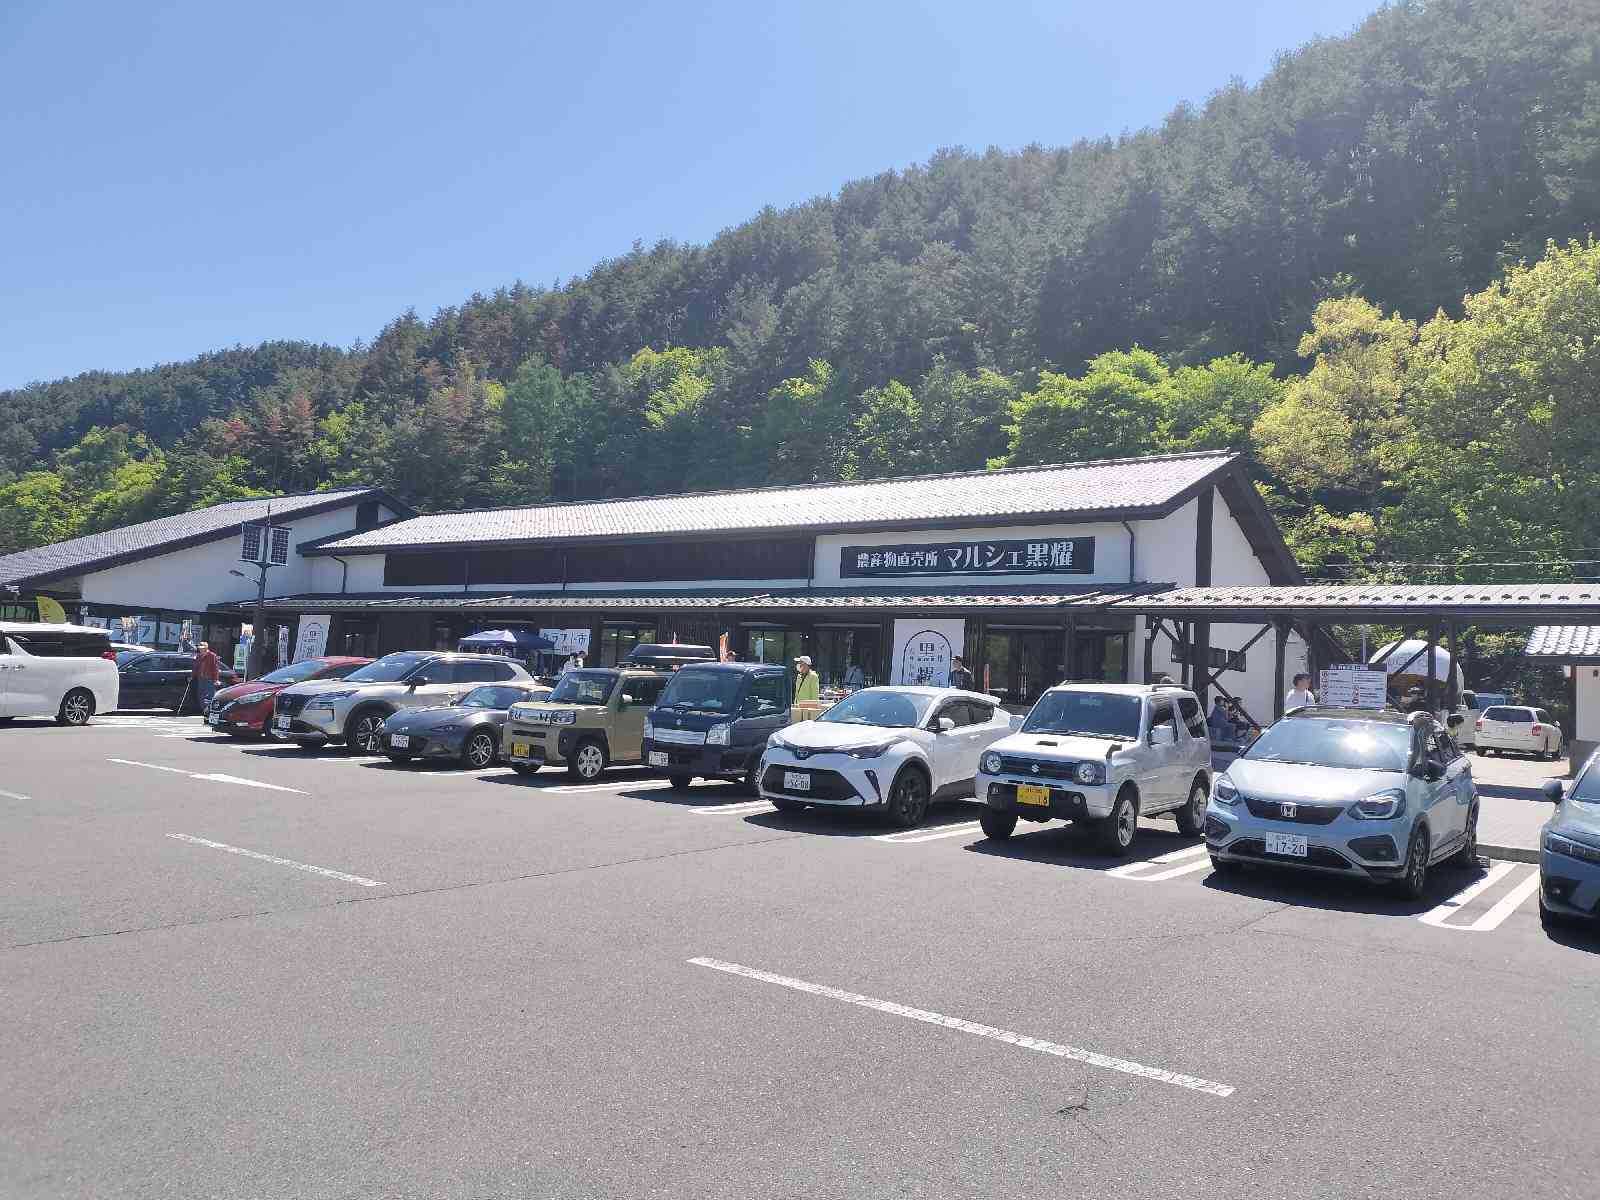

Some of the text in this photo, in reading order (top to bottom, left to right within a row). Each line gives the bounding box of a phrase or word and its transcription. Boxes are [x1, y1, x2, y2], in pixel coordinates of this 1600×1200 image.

[856, 541, 1075, 569] 農産物直売所 マルシェ黒耀
[1275, 840, 1305, 855] 17-20
